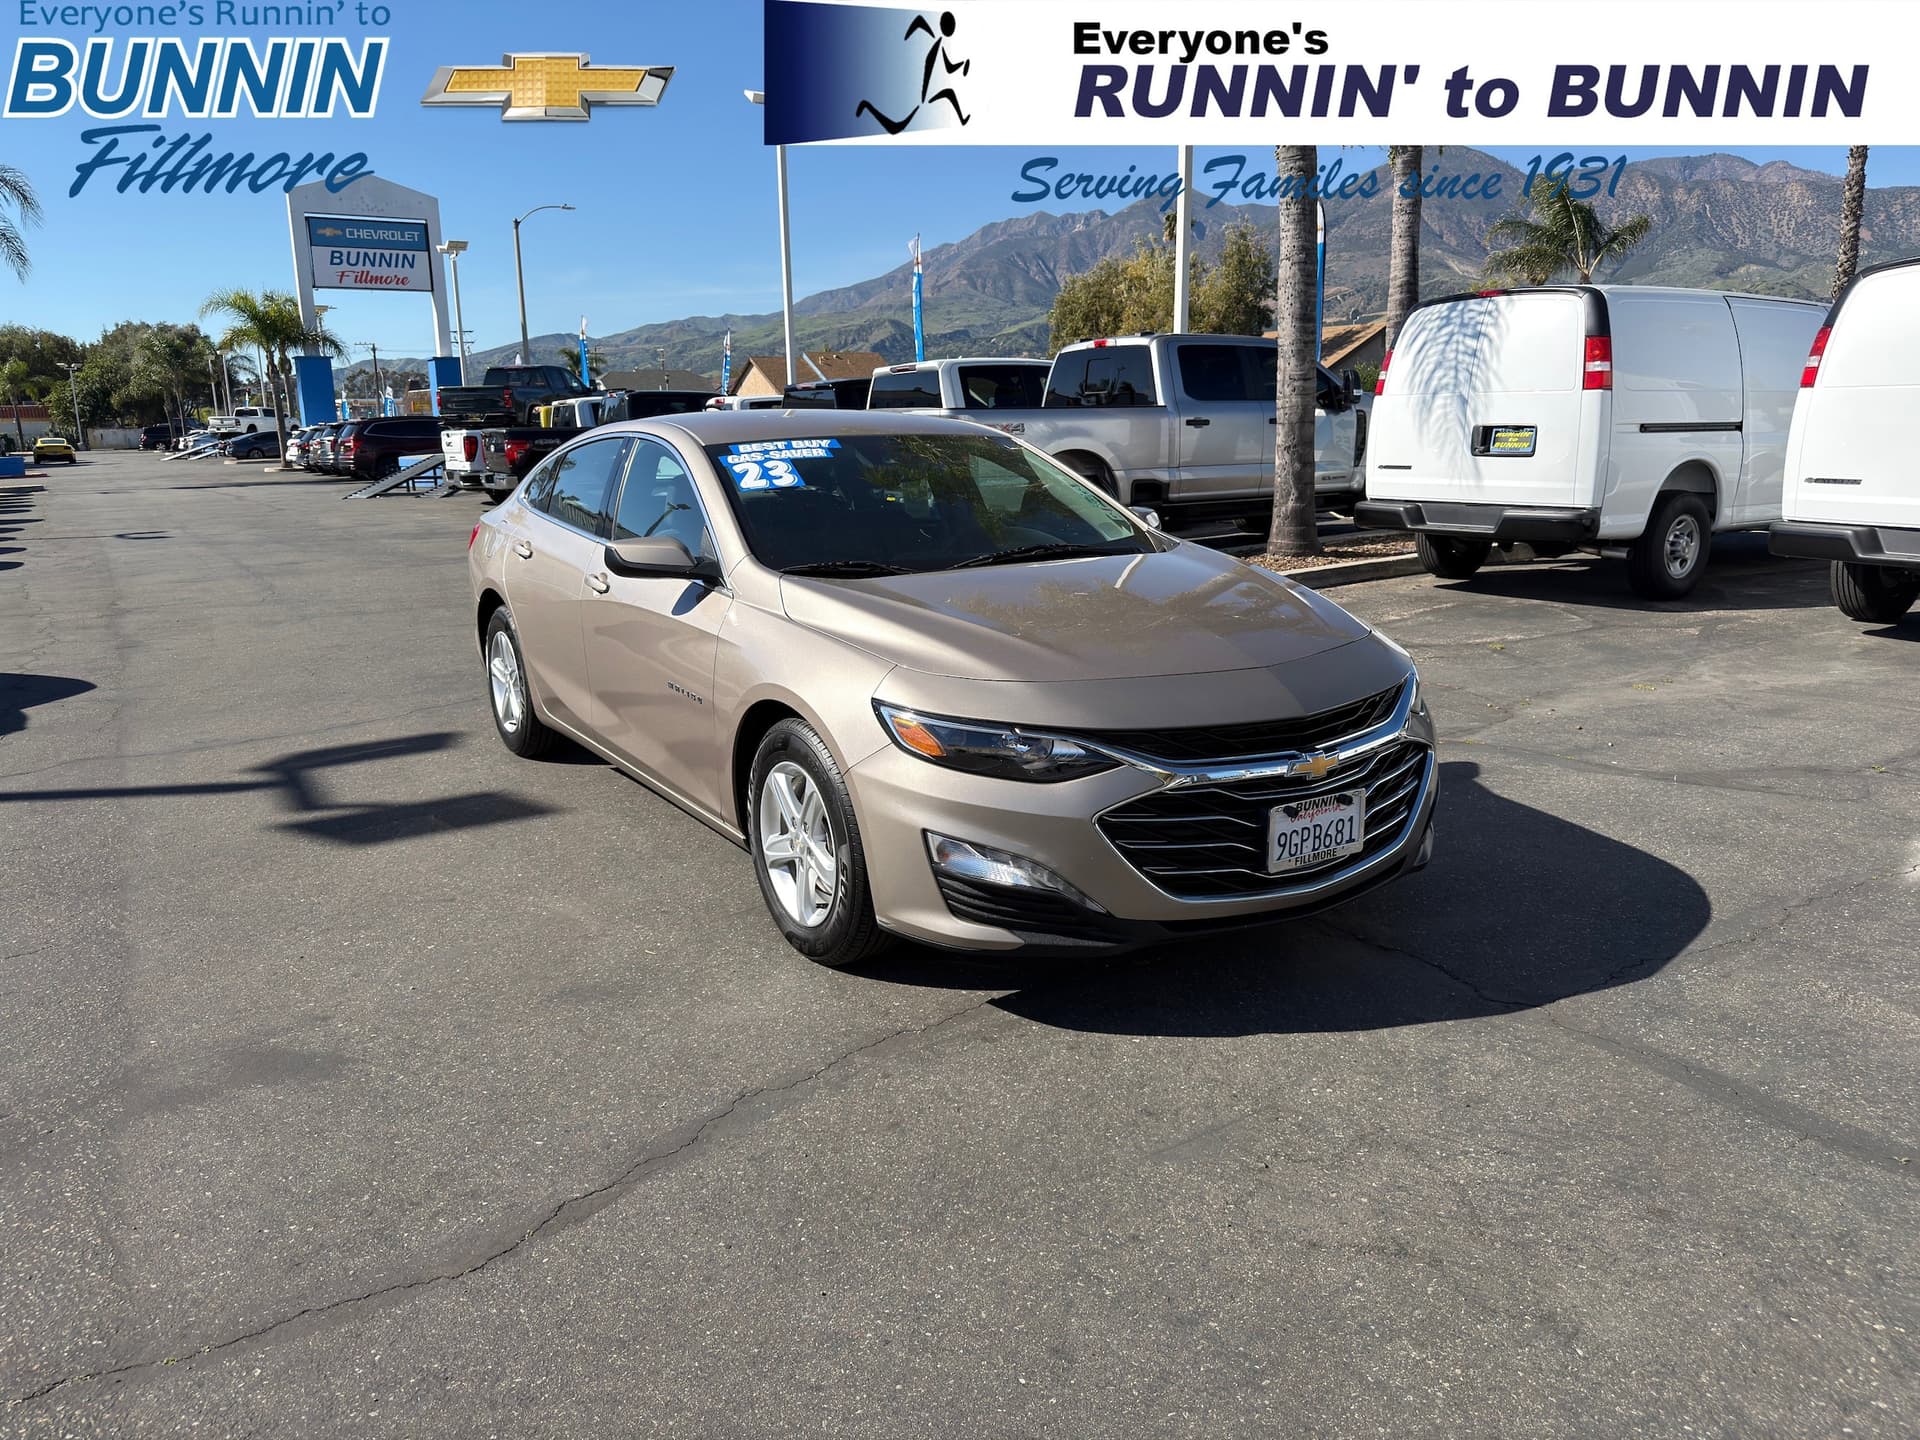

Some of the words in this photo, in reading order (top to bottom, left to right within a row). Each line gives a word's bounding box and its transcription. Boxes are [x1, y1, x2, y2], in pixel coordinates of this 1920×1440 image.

[345, 228, 419, 241] CHEVROLET
[329, 250, 416, 269] BUNNIN
[336, 270, 410, 286] Fillmore
[738, 441, 788, 453] BEST
[791, 439, 831, 449] BUY
[727, 448, 827, 464] GAS-SAVER
[732, 460, 799, 489] 23
[1276, 816, 1356, 861] 9GPB681
[1294, 848, 1338, 866] FILLMORE
